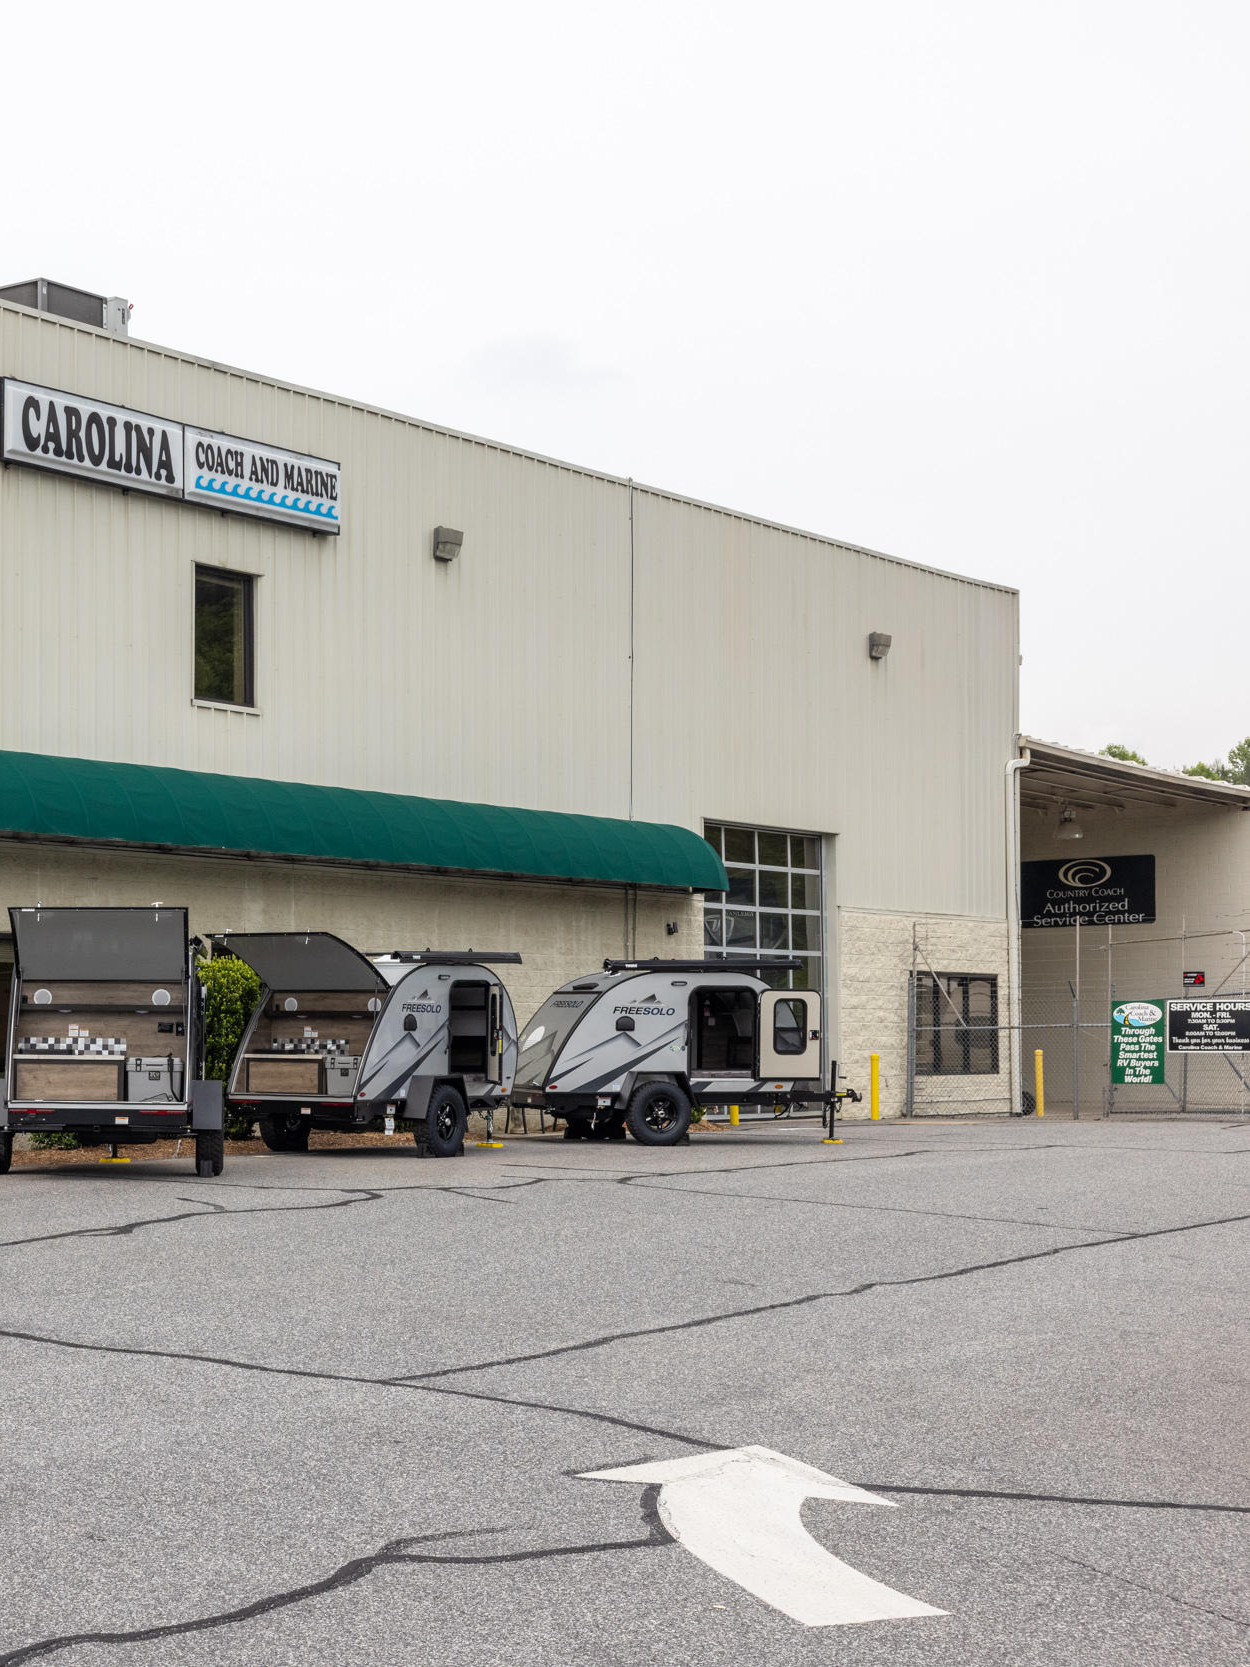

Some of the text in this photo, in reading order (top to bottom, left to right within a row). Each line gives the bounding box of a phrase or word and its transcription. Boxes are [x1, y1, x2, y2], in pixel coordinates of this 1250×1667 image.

[21, 395, 175, 484] CAROLINA
[195, 441, 338, 501] COACH AND MARINE
[1046, 887, 1125, 899] COUNTRY COACH
[1043, 897, 1128, 914] Authorized
[1033, 911, 1145, 927] Service Center
[401, 1003, 442, 1014] FREESOLO
[613, 1006, 675, 1016] FREESOLO
[1170, 1003, 1250, 1011] SERVICE HOURS
[1121, 1027, 1155, 1036] Through
[1113, 1035, 1163, 1043] These Gates
[1120, 1043, 1156, 1051] Pass The
[1118, 1051, 1157, 1059] Smartest
[1117, 1059, 1159, 1068] RV Buyers
[1125, 1067, 1150, 1075] In The
[1124, 1075, 1152, 1083] World!
